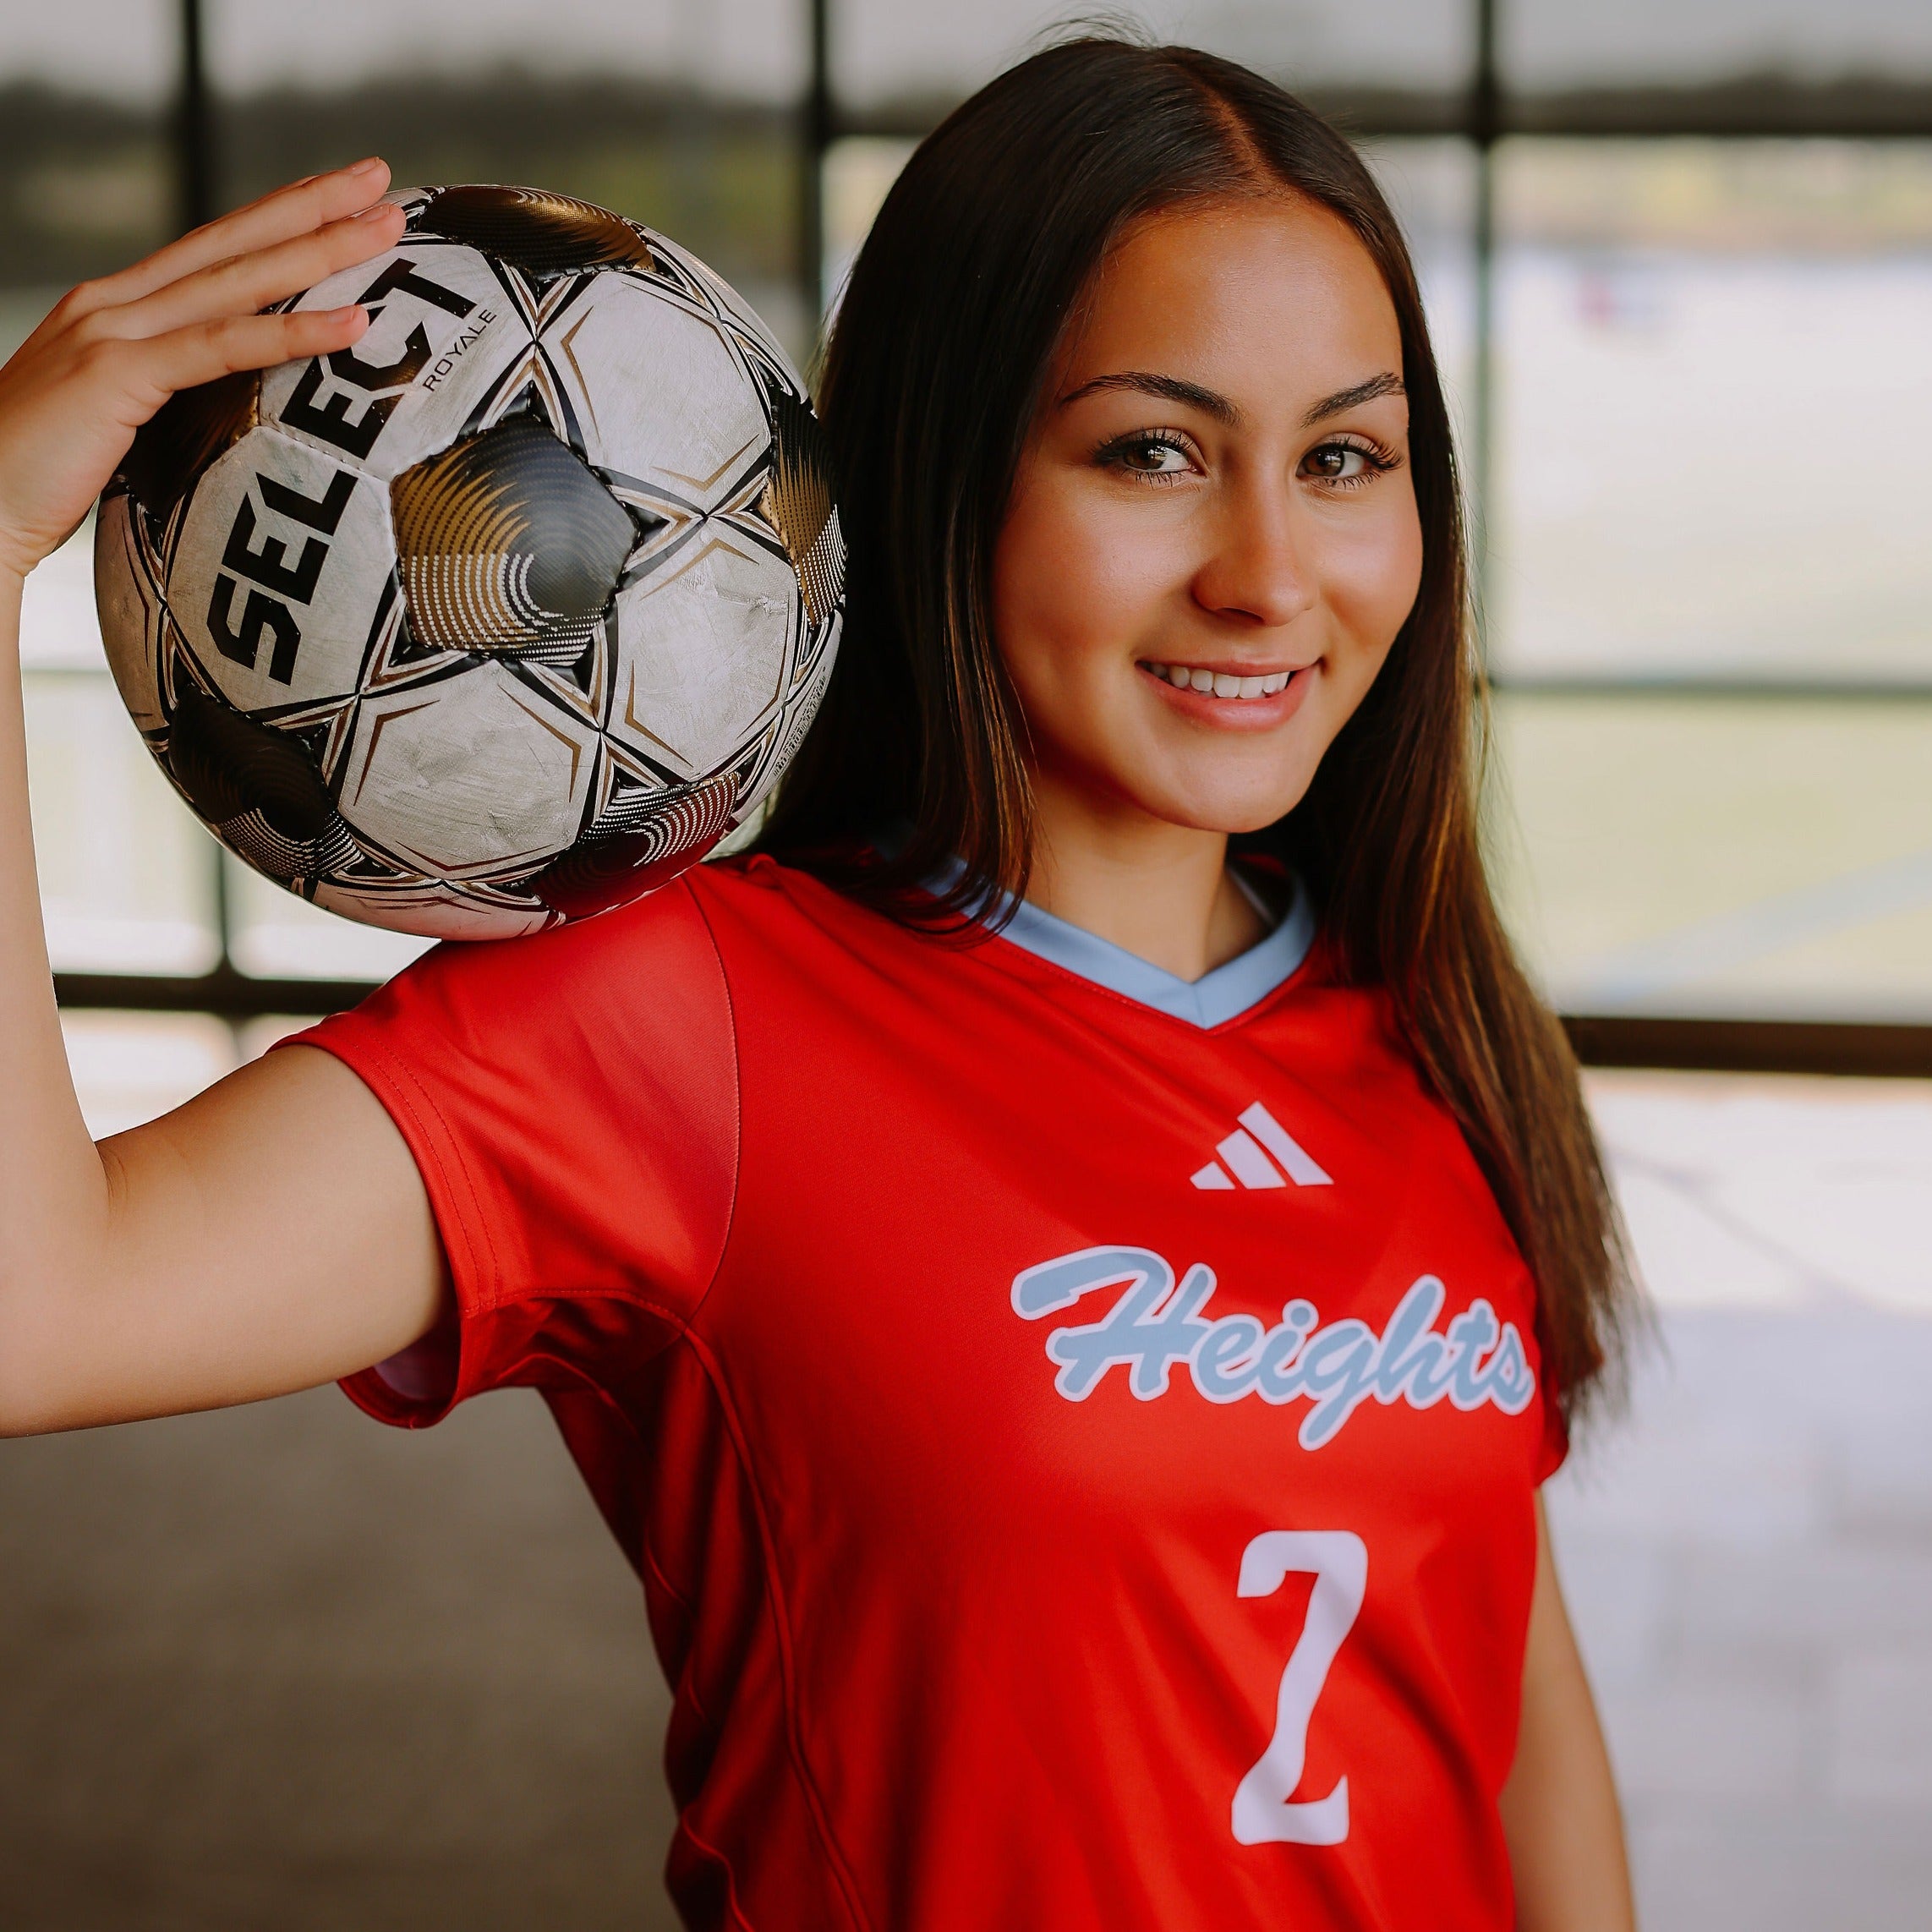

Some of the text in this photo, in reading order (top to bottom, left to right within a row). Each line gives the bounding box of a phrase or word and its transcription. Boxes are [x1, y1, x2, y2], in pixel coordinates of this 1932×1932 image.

[206, 258, 477, 686] SELECT
[423, 309, 497, 391] ROYALE
[1011, 1245, 1535, 1452] Heights
[1231, 1530, 1368, 1846] 2
